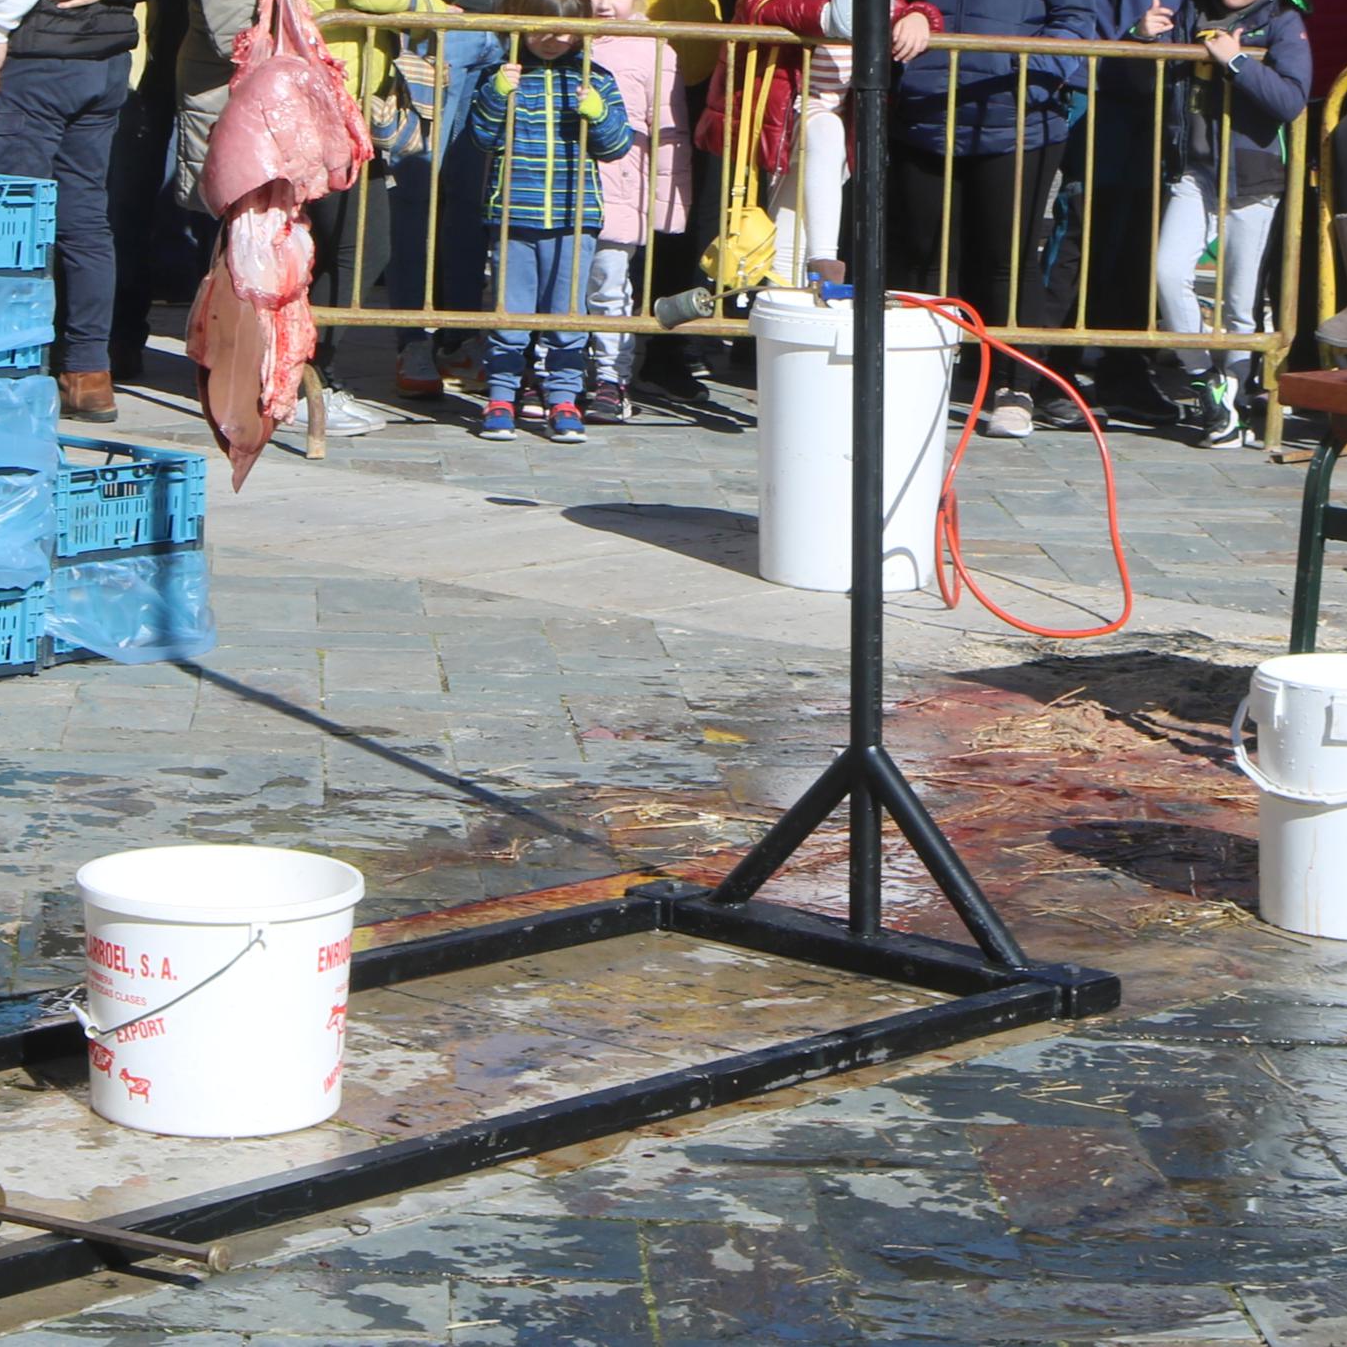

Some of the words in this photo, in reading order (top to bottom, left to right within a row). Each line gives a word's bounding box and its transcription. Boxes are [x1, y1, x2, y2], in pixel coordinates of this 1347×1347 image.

[140, 953, 155, 979] S.
[160, 956, 179, 981] A.
[115, 992, 147, 1006] CLASES
[116, 1018, 166, 1043] EXPORT
